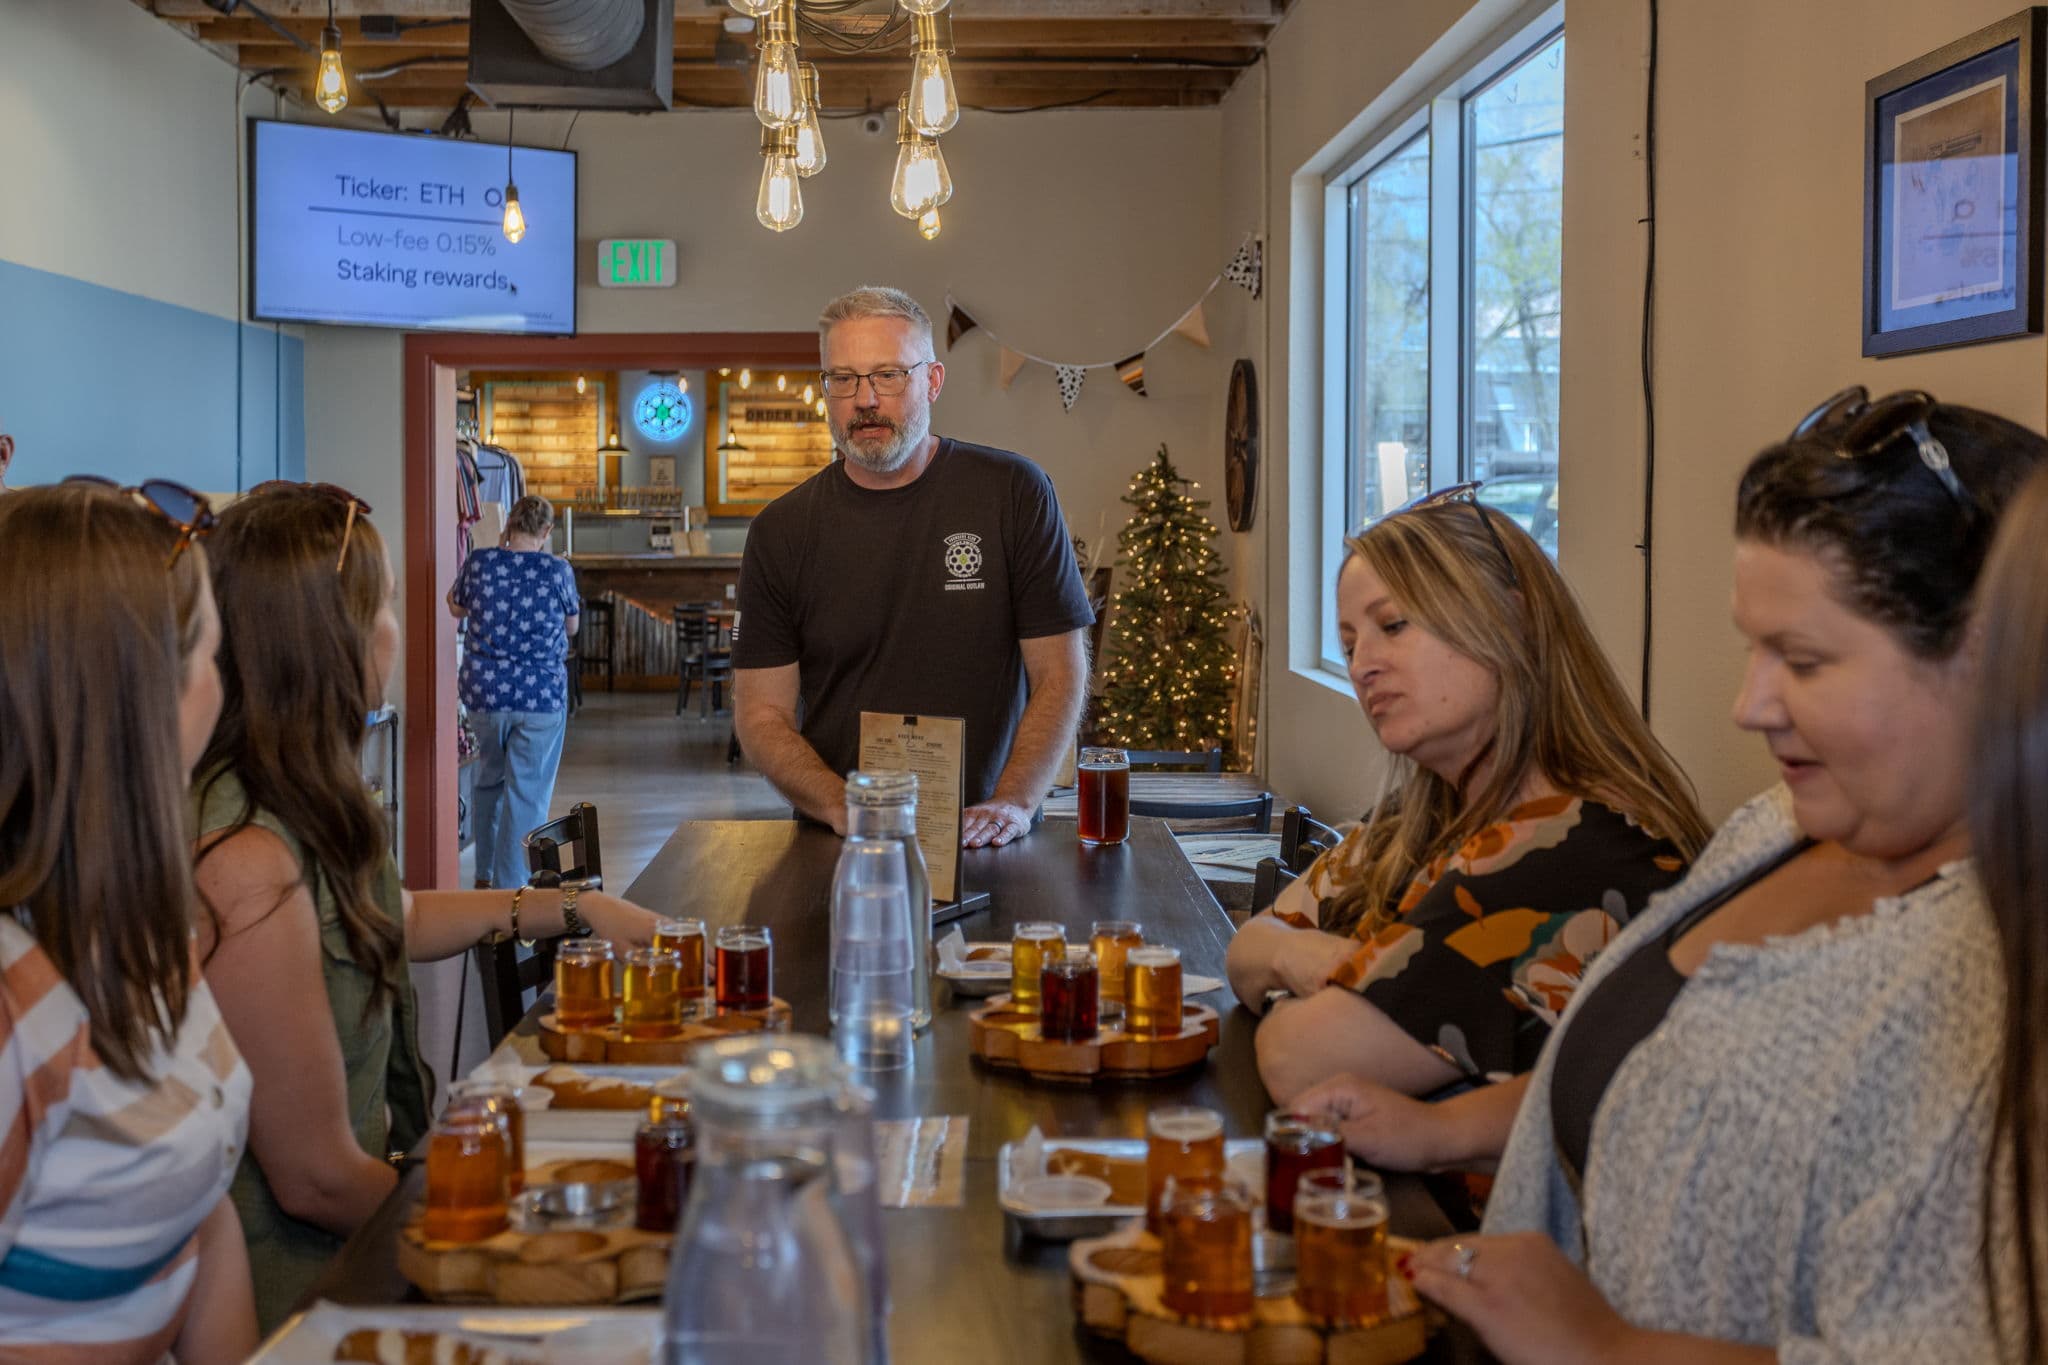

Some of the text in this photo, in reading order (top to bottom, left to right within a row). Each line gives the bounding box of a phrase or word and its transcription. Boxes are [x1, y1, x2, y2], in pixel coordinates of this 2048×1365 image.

[335, 174, 465, 206] Ticker: ETH
[337, 224, 497, 257] Low-fee 0.15%
[337, 258, 508, 290] Staking rewards
[611, 241, 666, 283] EXIT
